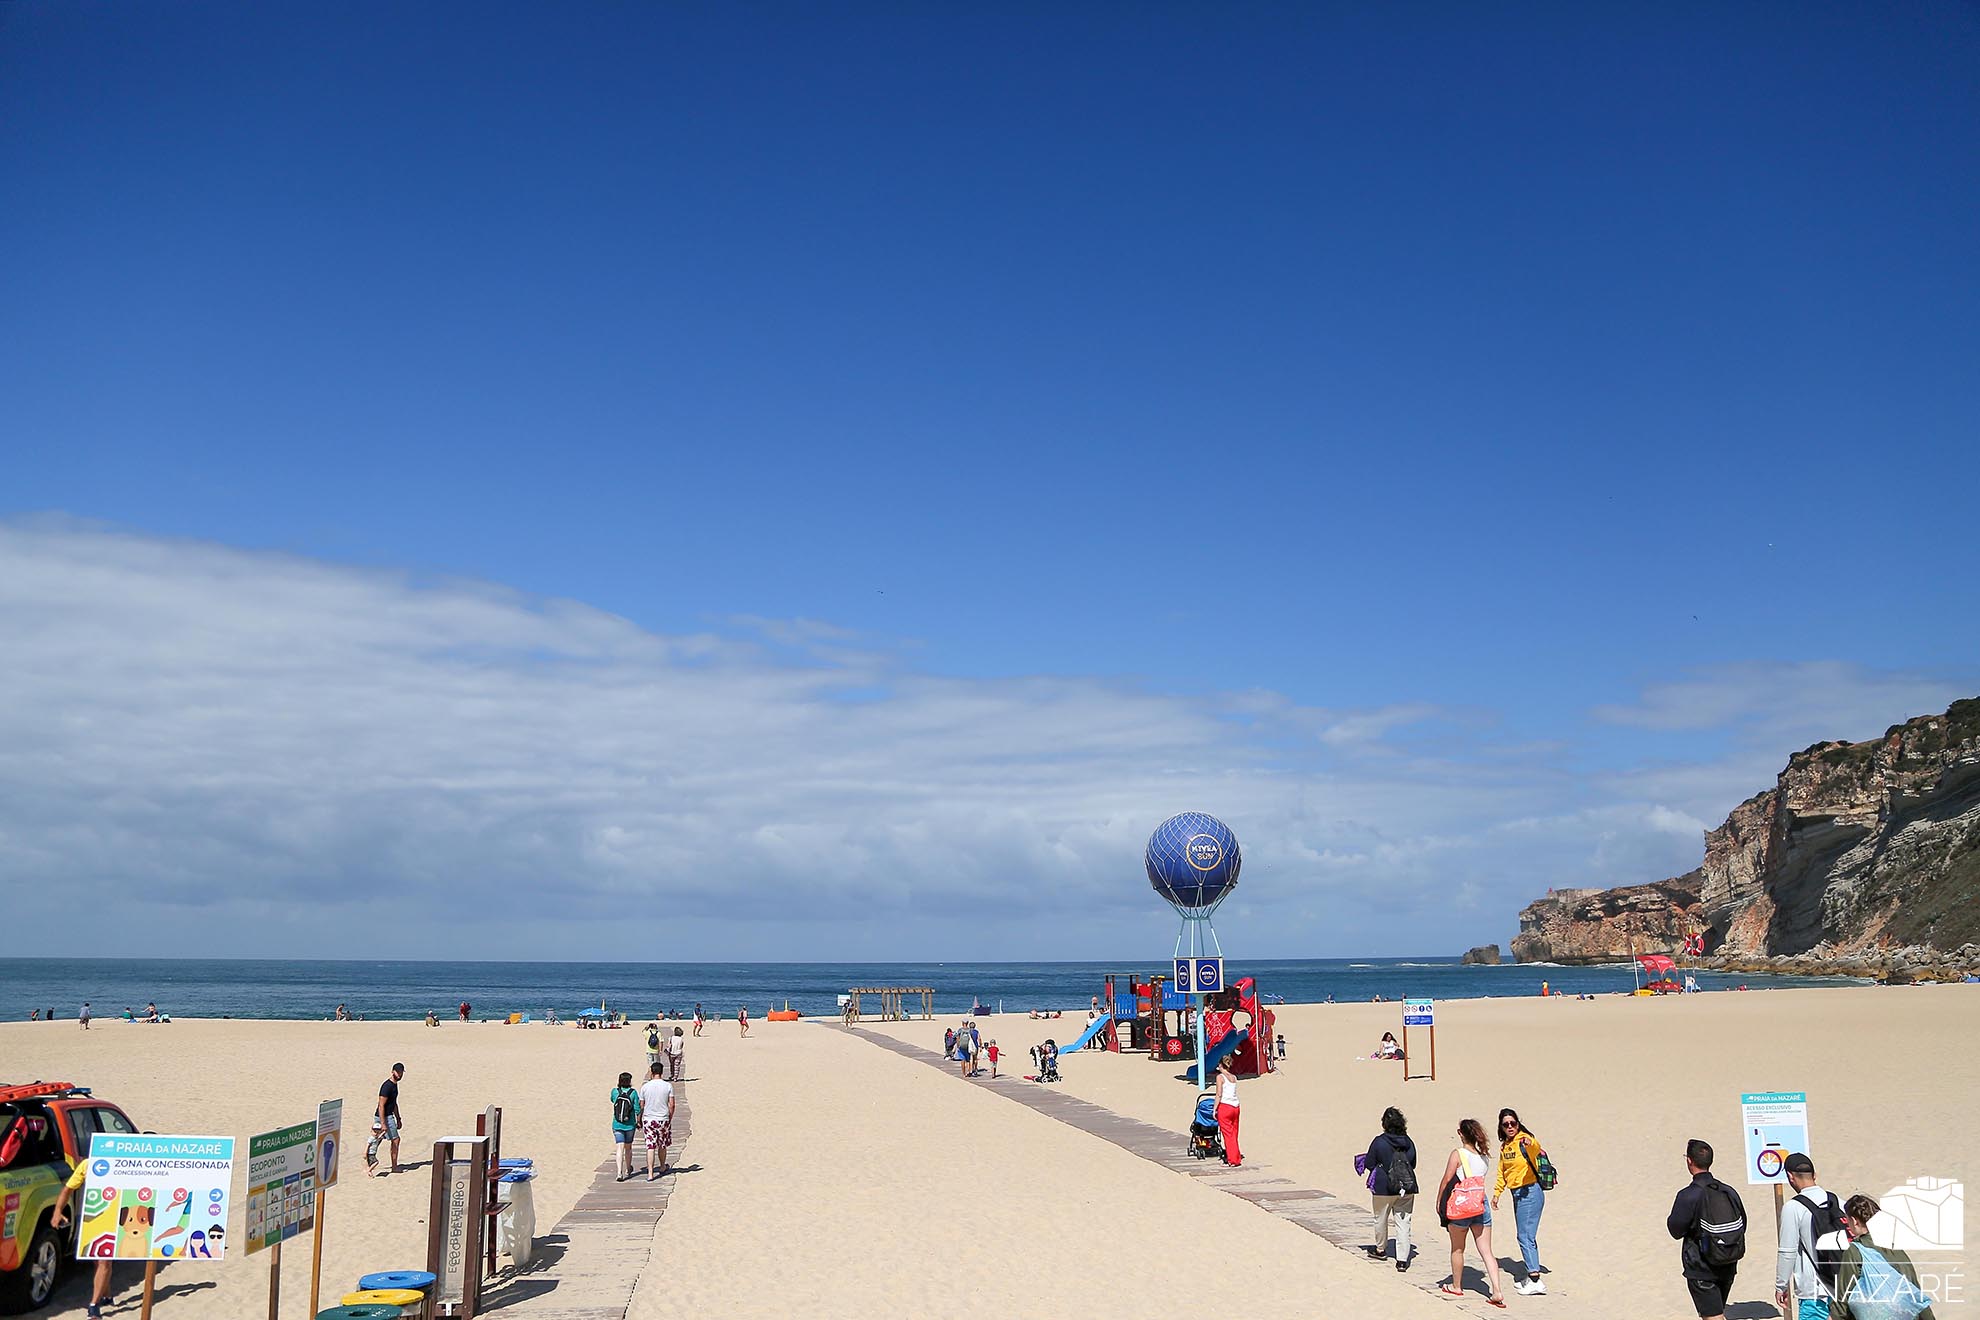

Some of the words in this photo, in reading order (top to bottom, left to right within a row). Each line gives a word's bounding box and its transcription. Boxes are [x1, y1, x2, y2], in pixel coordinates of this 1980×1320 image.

[116, 1142, 153, 1153] PRAIA
[155, 1145, 169, 1153] DA
[171, 1142, 223, 1154] NAZARÉ
[262, 1138, 281, 1149] PRAIA
[114, 1159, 143, 1168] ZONA
[145, 1160, 230, 1169] CONCESSIONADA
[250, 1155, 286, 1173] ECOPONTO
